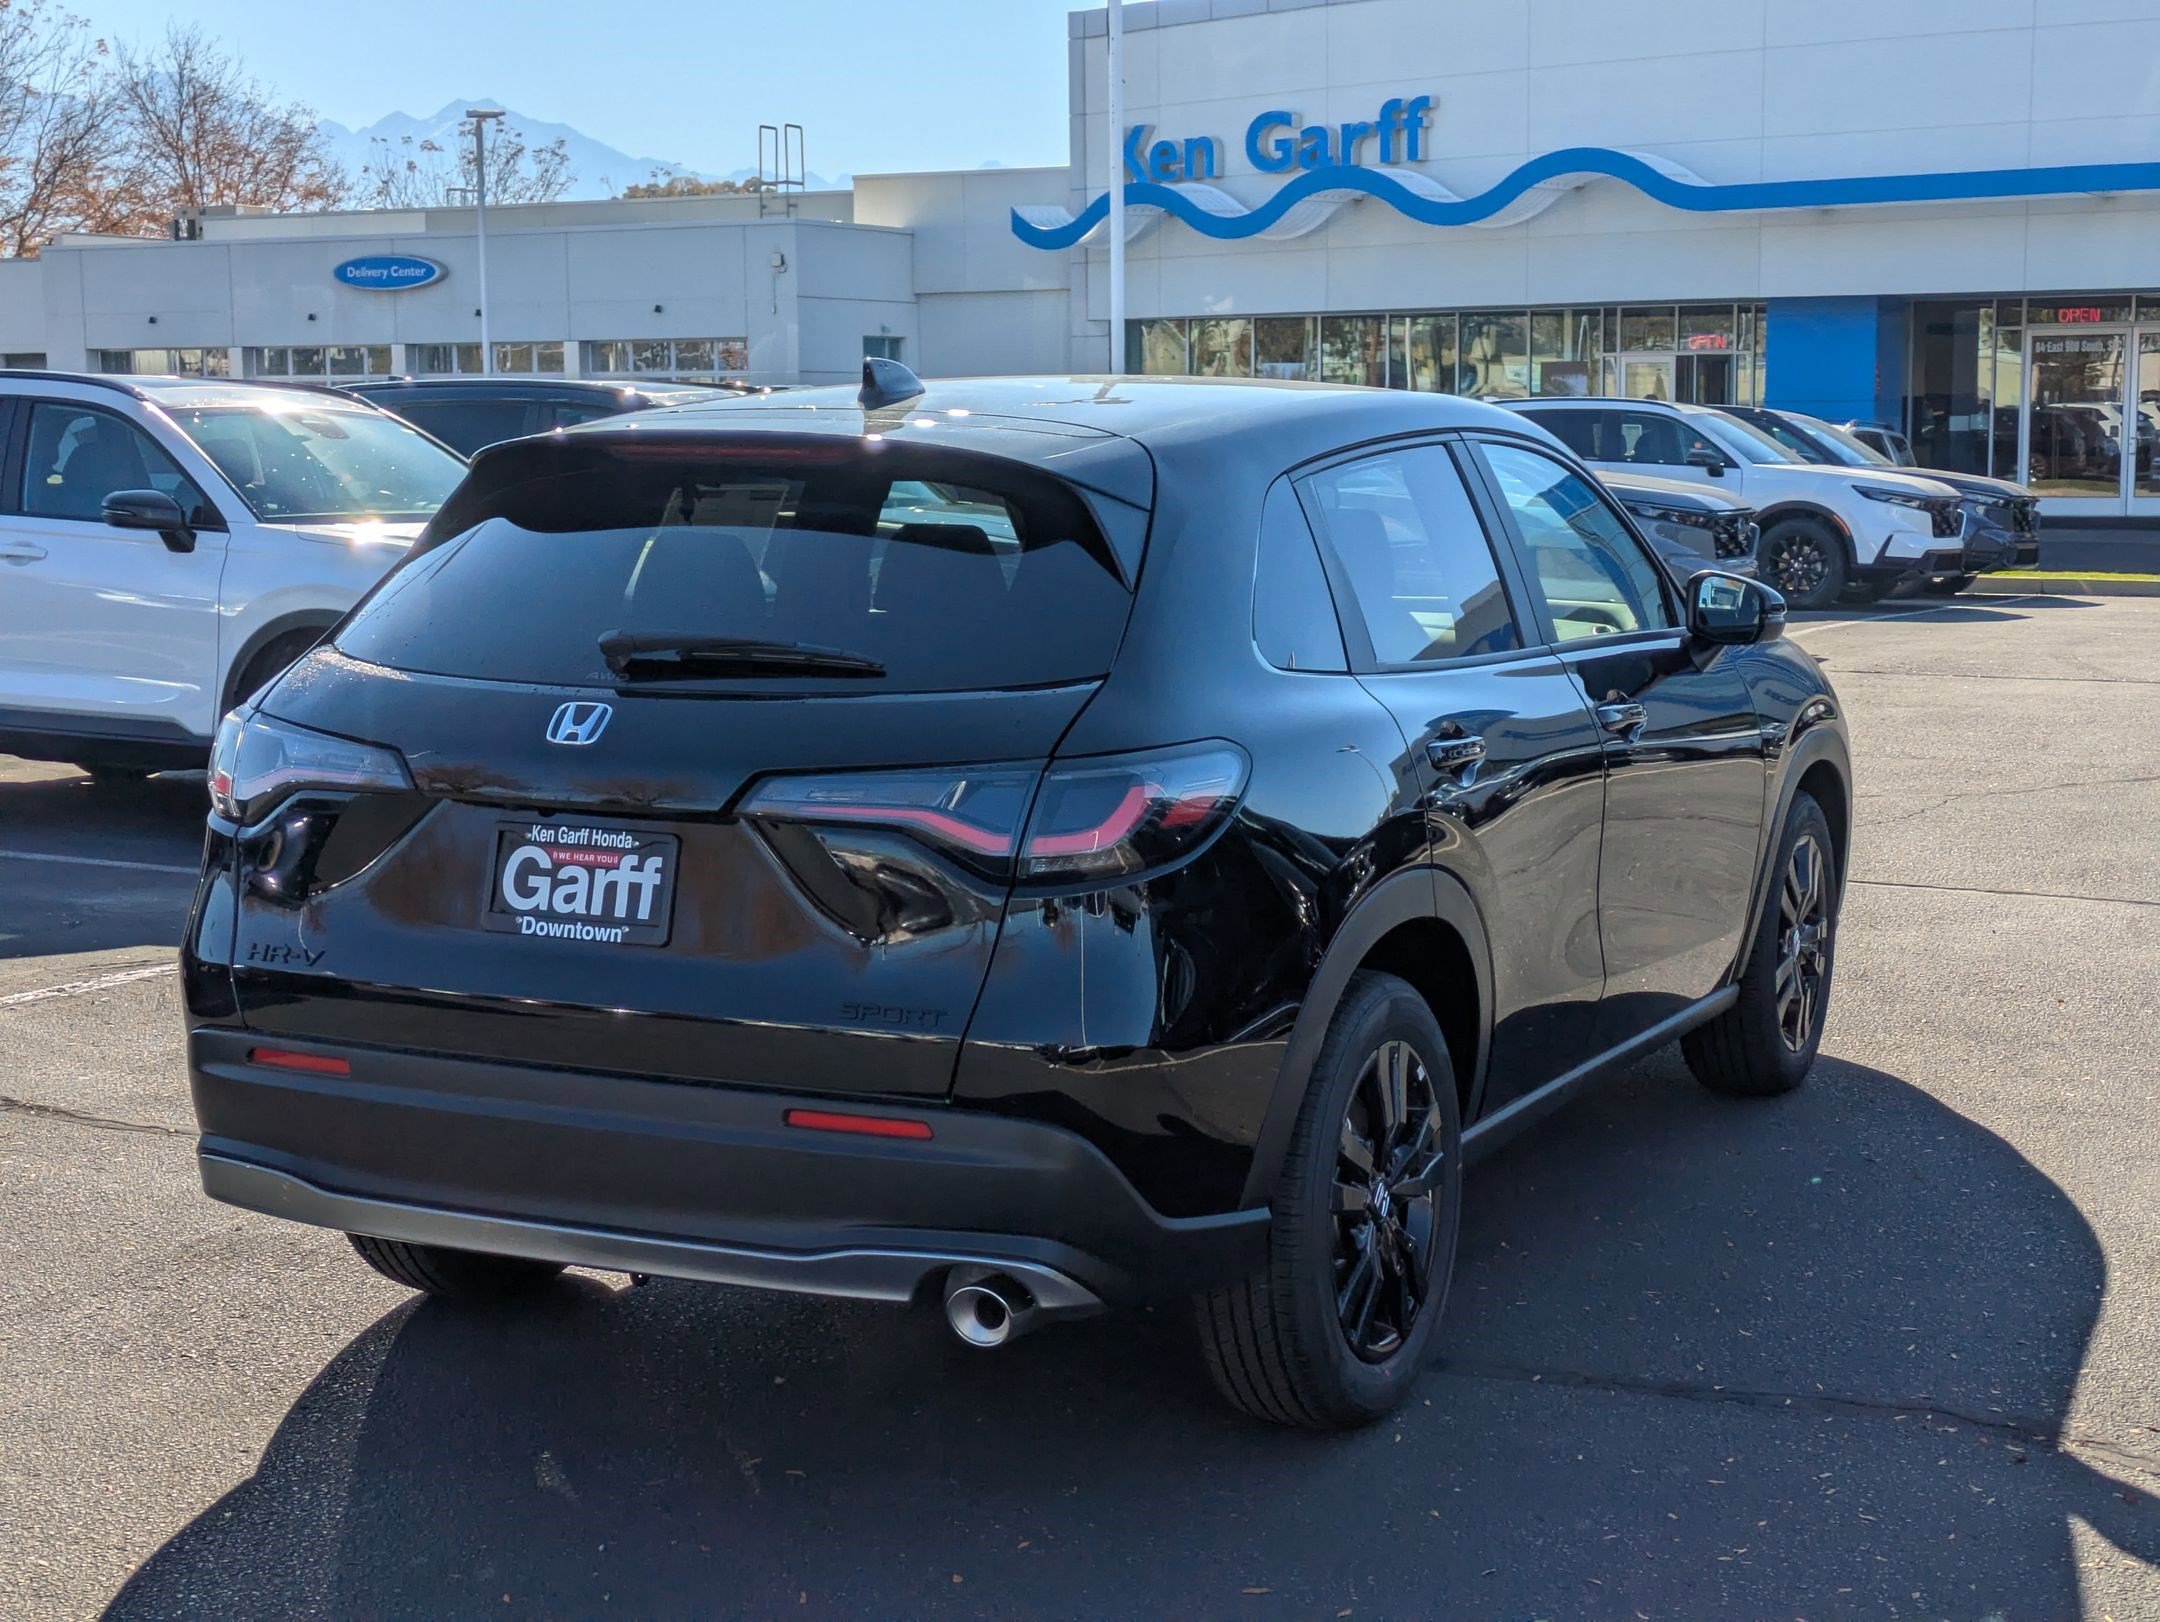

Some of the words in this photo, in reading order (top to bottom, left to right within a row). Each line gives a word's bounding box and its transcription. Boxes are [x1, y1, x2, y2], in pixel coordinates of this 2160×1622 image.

[1245, 95, 1432, 173] Garff
[346, 266, 388, 280] Delivery
[390, 266, 426, 277] Center
[2058, 307, 2101, 323] OPEN
[2047, 341, 2063, 352] East
[531, 824, 555, 843] Ken
[558, 826, 590, 844] Garff
[591, 829, 633, 849] Honda
[559, 853, 572, 861] WE
[573, 854, 595, 863] HEAR
[597, 855, 613, 864] YOU
[502, 845, 663, 920] Garff
[521, 916, 623, 943] Downtown
[248, 942, 327, 967] HR-V
[840, 1002, 949, 1027] SPORT
